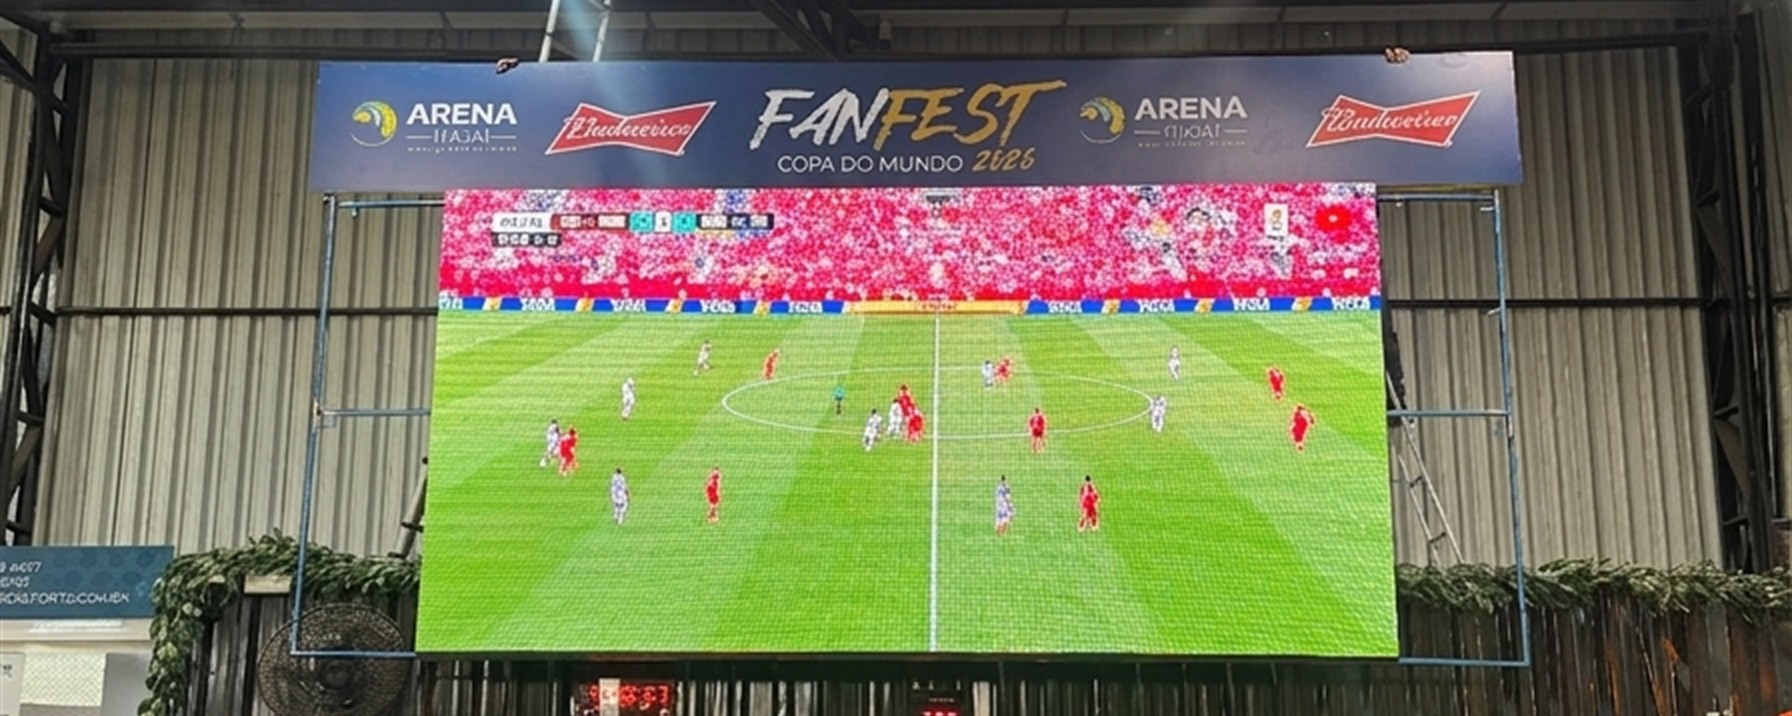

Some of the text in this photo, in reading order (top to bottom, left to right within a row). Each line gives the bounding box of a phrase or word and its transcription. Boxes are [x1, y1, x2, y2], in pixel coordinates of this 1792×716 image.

[406, 103, 518, 125] ARENA
[749, 79, 1067, 150] FANFEST
[1134, 95, 1248, 120] ARENA
[777, 155, 835, 173] COPA
[841, 155, 873, 173] DO
[879, 155, 963, 173] MUNDO
